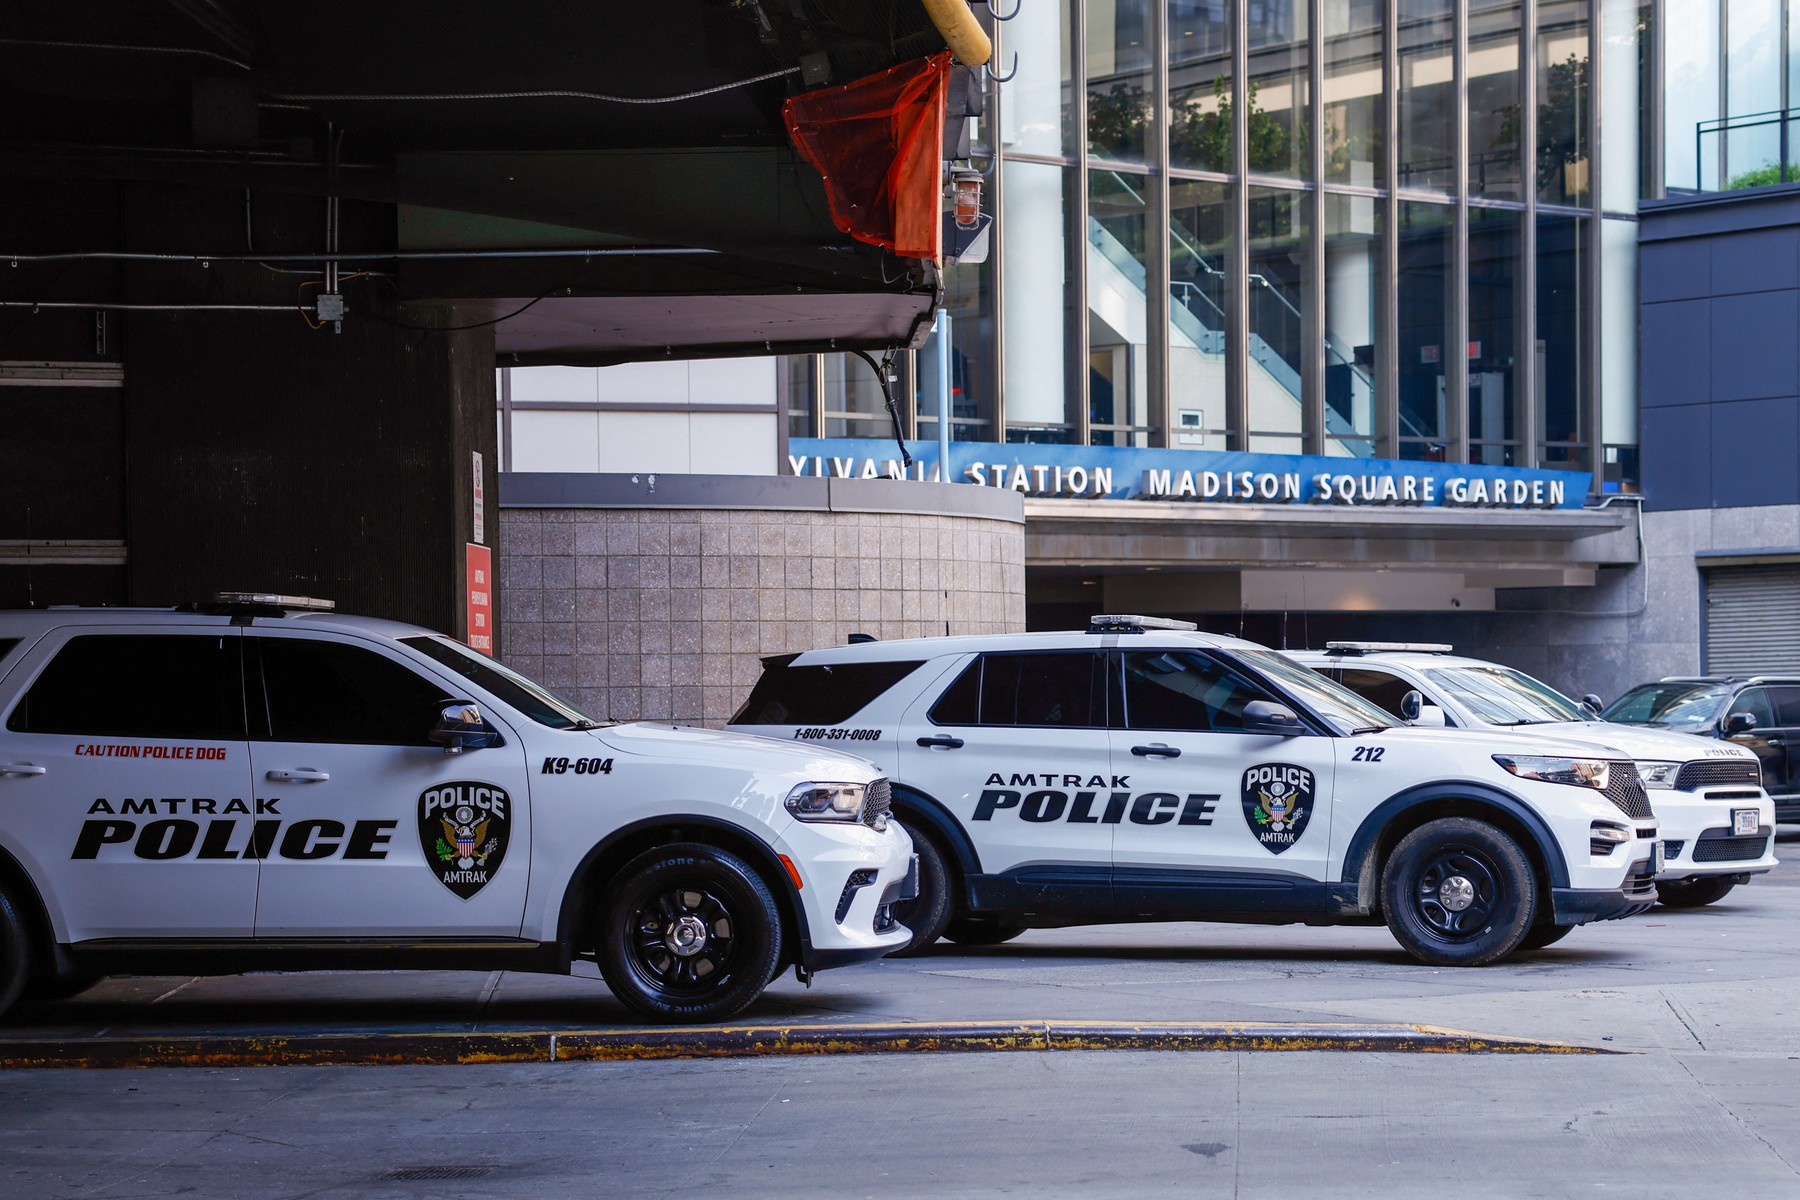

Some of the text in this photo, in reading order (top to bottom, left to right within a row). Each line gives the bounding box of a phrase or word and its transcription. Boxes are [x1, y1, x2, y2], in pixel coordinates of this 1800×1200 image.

[970, 461, 1113, 494] STATION
[1148, 468, 1301, 500] MADISON
[1319, 473, 1436, 505] SQUARE
[1451, 477, 1566, 505] GARDEN
[794, 728, 882, 740] 1-800-331-0008
[75, 744, 226, 760] CAUTION POLICE DOG
[1351, 746, 1385, 762] 212
[1703, 749, 1744, 757] POLICE
[541, 757, 614, 775] K9-604
[985, 772, 1131, 788] AMTRAK
[1246, 766, 1311, 794] POLICE
[86, 798, 281, 815] AMTRAK
[425, 787, 504, 820] POLICE
[971, 790, 1221, 826] POLICE
[70, 819, 398, 860] POLICE
[1260, 832, 1295, 844] AMTRAK
[443, 870, 487, 883] AMTRAK
